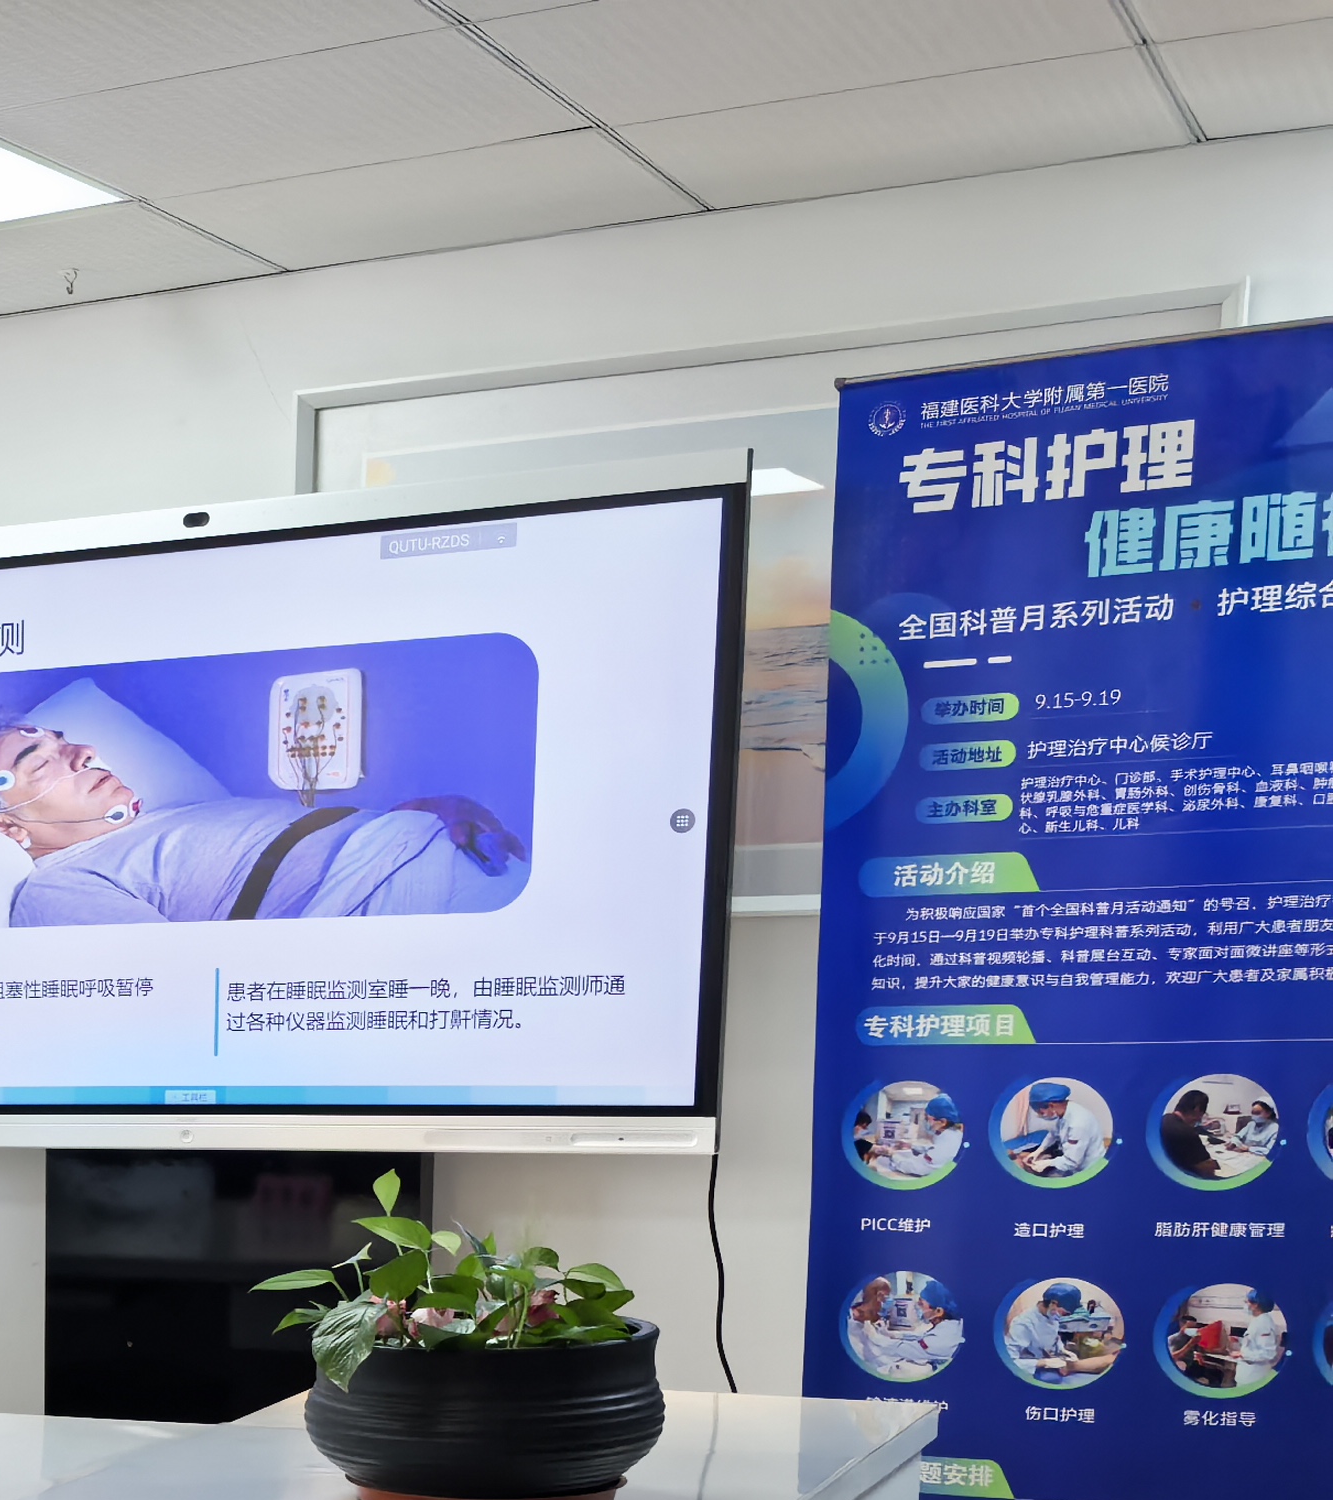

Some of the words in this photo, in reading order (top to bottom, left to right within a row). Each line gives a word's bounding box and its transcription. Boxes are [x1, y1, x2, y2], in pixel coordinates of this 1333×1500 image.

[920, 374, 1169, 420] 福建医科大学附属第一医院
[899, 419, 1195, 513] 专科护理
[389, 534, 470, 554] QUTU-RZDS
[1084, 491, 1333, 578] 健康随
[898, 596, 1174, 641] 全国科普月系列活动
[935, 697, 1005, 719] 举办时间
[1036, 689, 1122, 710] 9.15-9.19
[933, 745, 1003, 766] 活动地址
[1027, 731, 1213, 759] 护理治疗中心候诊厅
[927, 797, 997, 818] 主办科室
[893, 861, 995, 888] 活动介绍
[228, 975, 625, 1002] 患者在睡眠监测室睡一晚，由睡眠监测师通
[227, 1009, 523, 1032] 过各种仪器监测睡眠和打鼾情况。
[864, 1014, 1015, 1039] 专科护理项目
[861, 1217, 931, 1234] PICC维护
[1014, 1222, 1084, 1239] 造口护理
[1154, 1221, 1286, 1239] 脂肪肝健康管理
[1025, 1406, 1095, 1424] 伤口护理
[1183, 1410, 1256, 1428] 雾化指导
[919, 1461, 994, 1487] 题安排
